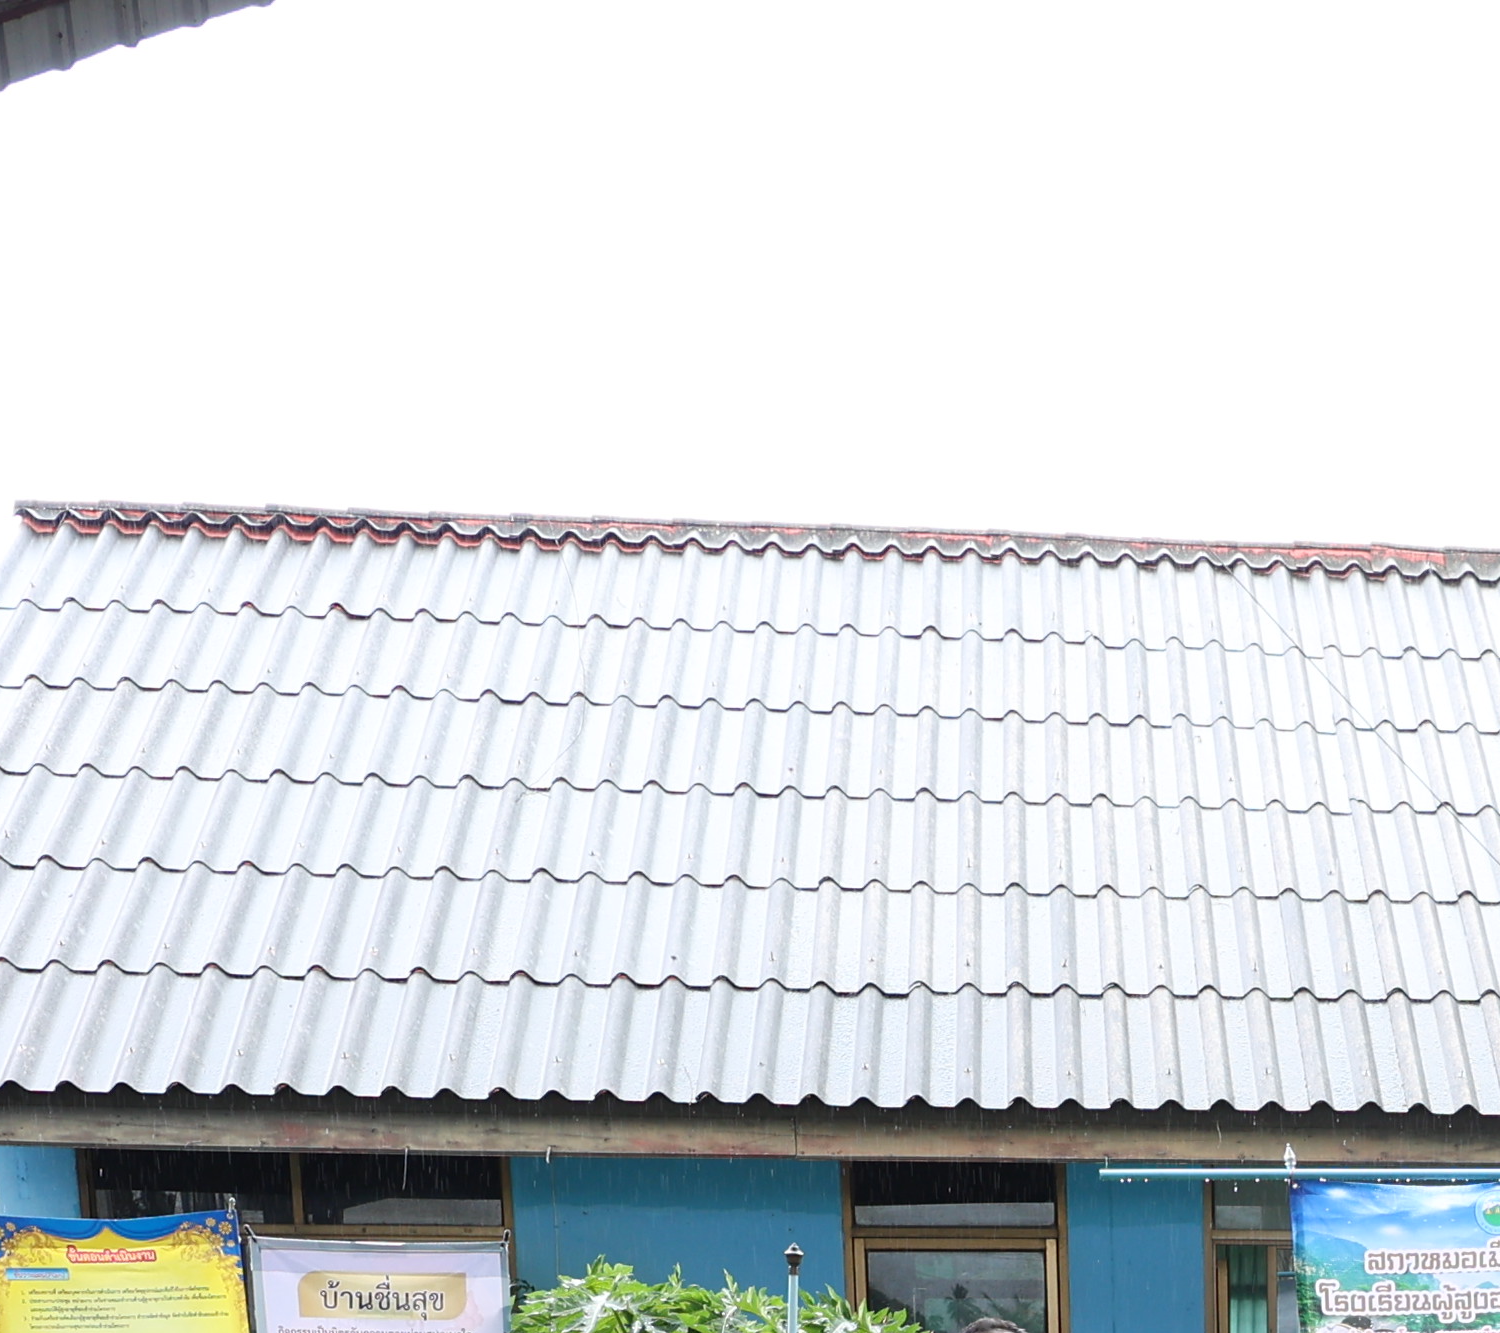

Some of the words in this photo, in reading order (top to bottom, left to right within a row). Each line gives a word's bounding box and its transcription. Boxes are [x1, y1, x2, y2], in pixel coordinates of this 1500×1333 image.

[67, 1247, 157, 1264] ขั้นตอนดำเนินงาน
[320, 1275, 444, 1321] บ้านชื่นสุข
